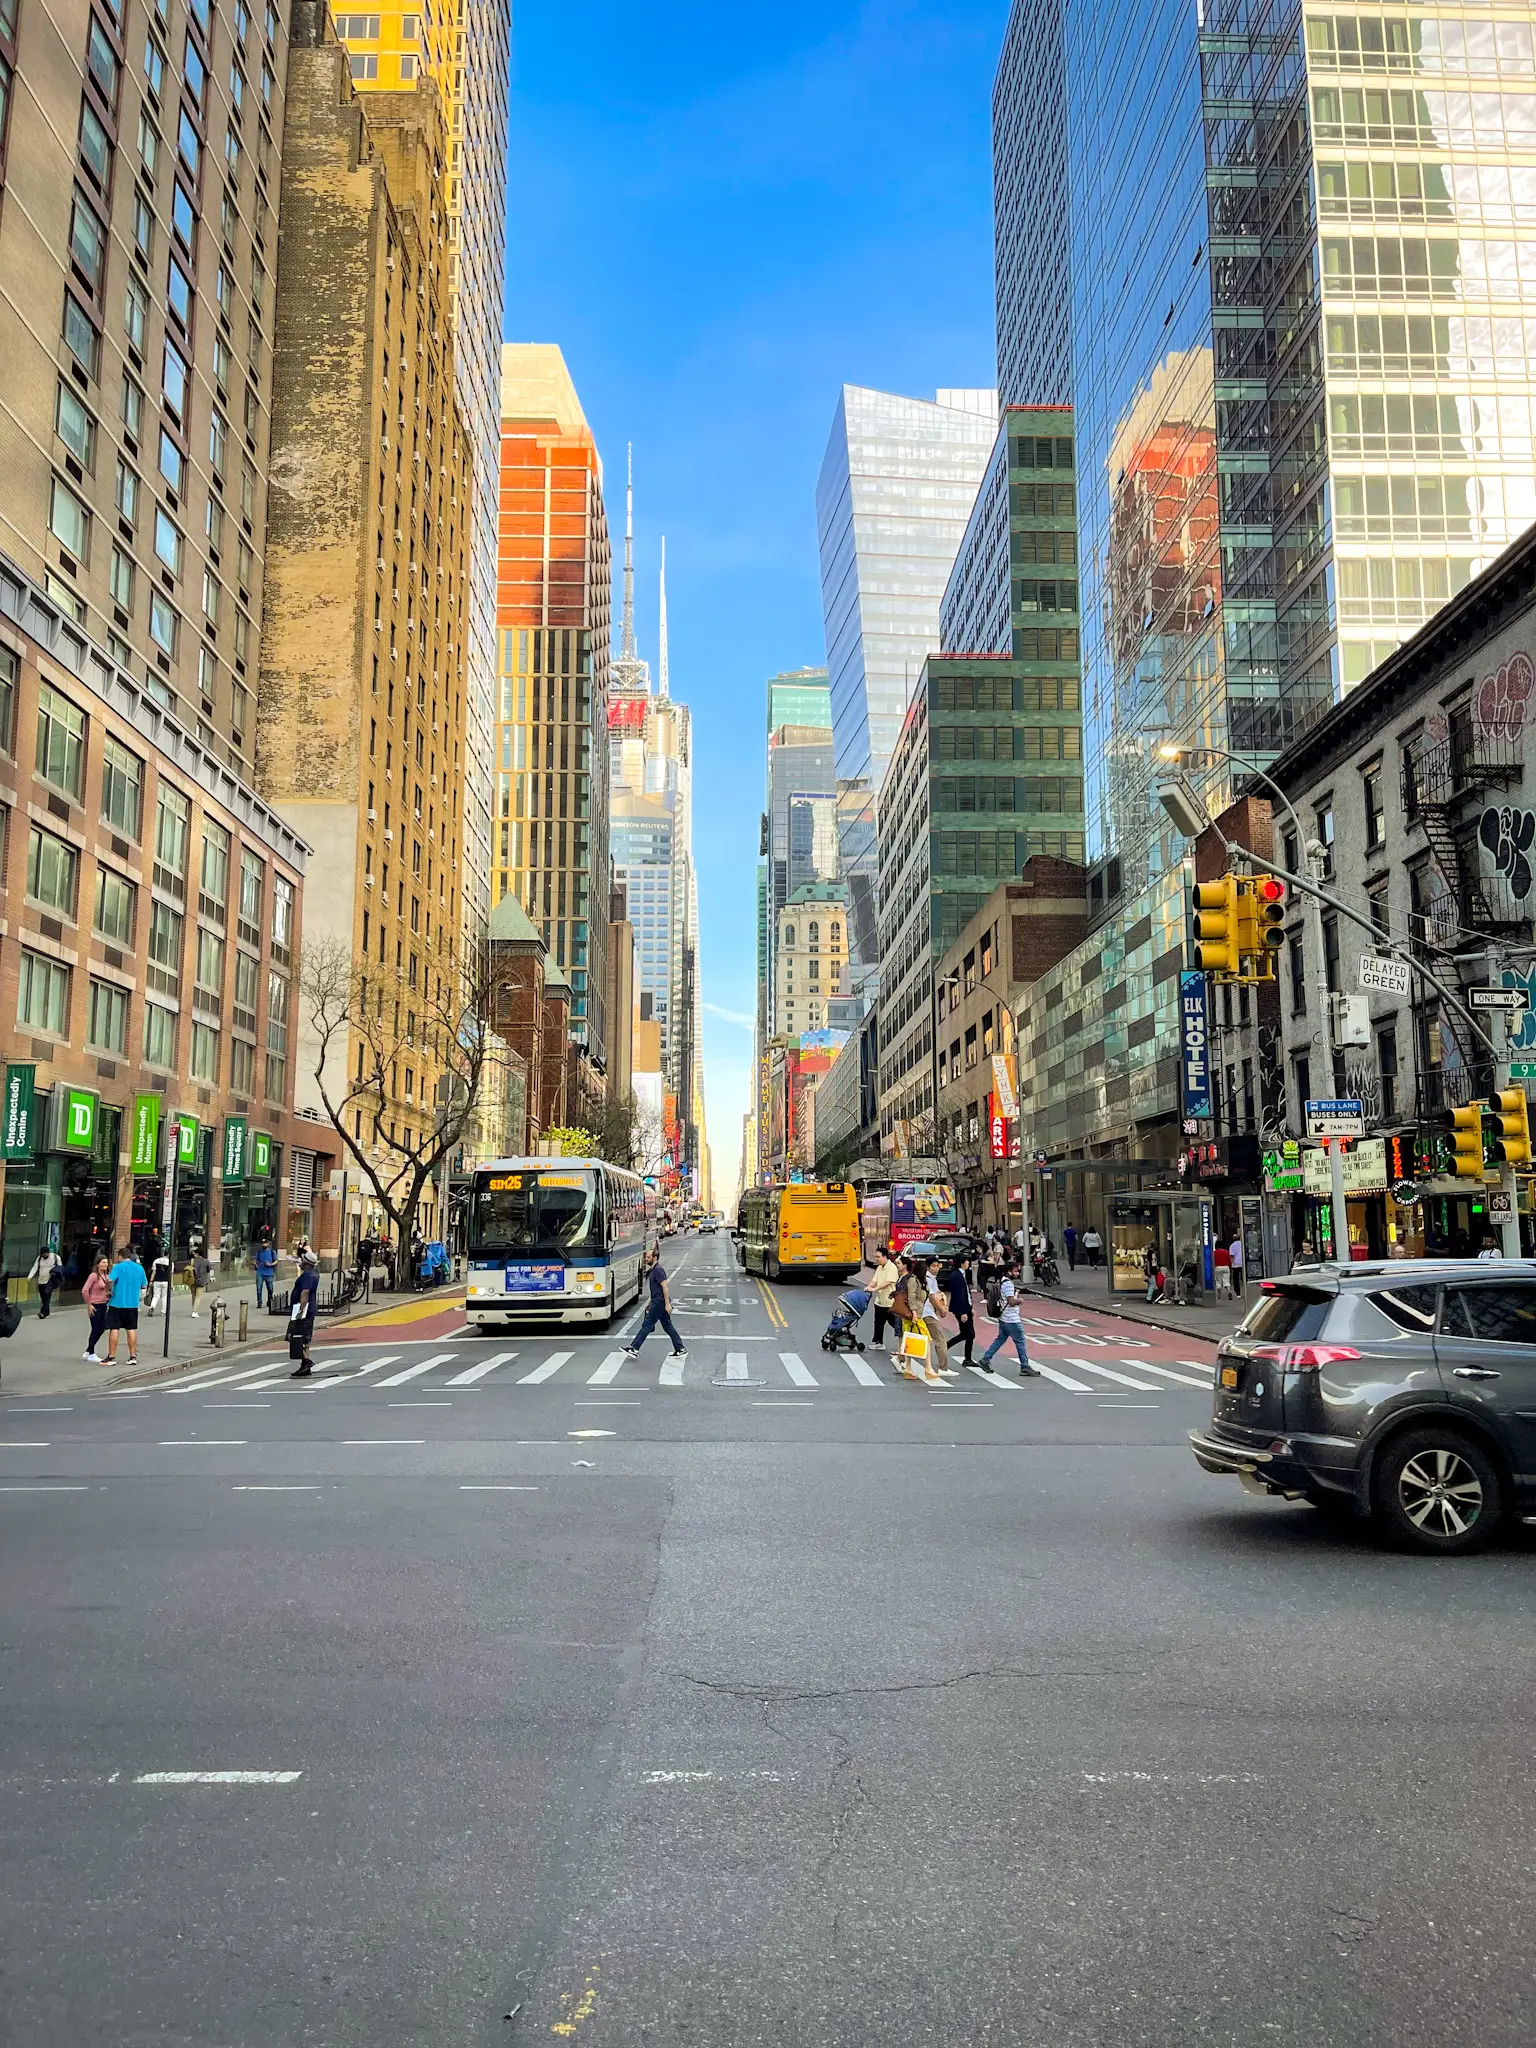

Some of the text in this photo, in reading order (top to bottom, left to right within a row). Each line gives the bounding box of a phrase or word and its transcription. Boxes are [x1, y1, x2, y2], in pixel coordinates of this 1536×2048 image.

[610, 821, 669, 830] HOMSON REUTERS
[1363, 958, 1406, 979] DELAYED
[1363, 973, 1405, 992] GREEN
[1183, 997, 1203, 1014] ELK
[1478, 994, 1521, 1004] ONE WAY
[1185, 1016, 1206, 1091] HOTEL
[761, 1056, 770, 1103] MADAME
[1521, 1064, 1529, 1077] 9
[6, 1077, 21, 1147] Unexpectedly
[72, 1103, 91, 1136] TD
[17, 1110, 28, 1147] Canine
[136, 1105, 148, 1164] Unexpectedly
[181, 1125, 194, 1153] TD
[993, 1117, 1003, 1146] ARK
[144, 1133, 153, 1164] Human
[226, 1125, 236, 1175] Unexpectedly
[233, 1126, 243, 1175] Times Square
[257, 1142, 268, 1167] TD
[1376, 1150, 1385, 1159] LATE
[1392, 1136, 1403, 1178] PIZZA
[489, 1175, 523, 1191] SIM25
[1393, 1180, 1417, 1191] FLOWER
[480, 1193, 492, 1201] 336
[1396, 1193, 1420, 1206] CAPITAL
[1024, 1334, 1151, 1348] BUS
